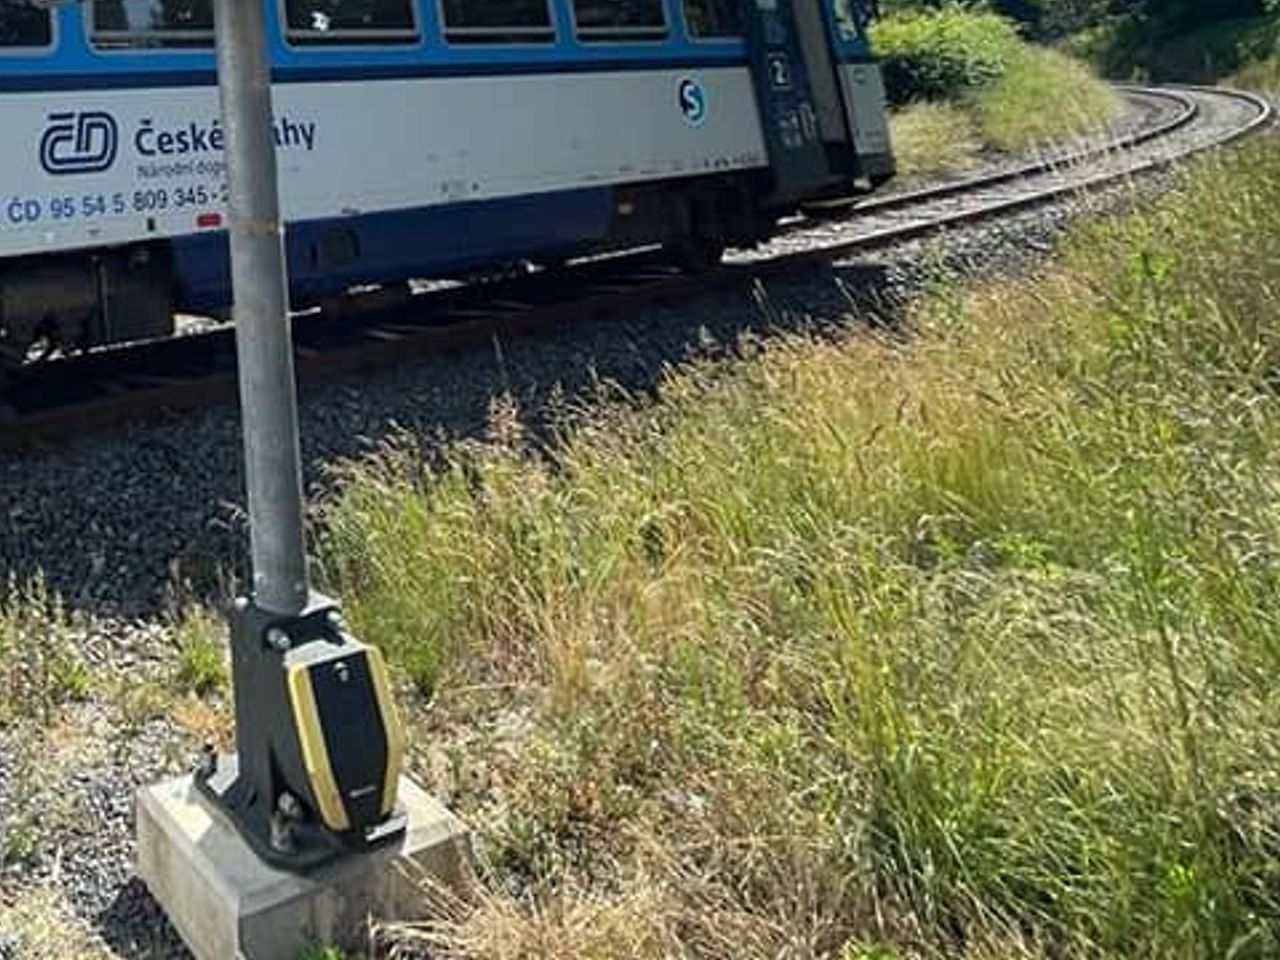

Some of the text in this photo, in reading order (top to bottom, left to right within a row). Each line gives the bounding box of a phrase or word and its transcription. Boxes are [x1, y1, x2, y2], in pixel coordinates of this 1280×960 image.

[135, 119, 226, 156] České
[7, 197, 42, 223] ČD
[50, 197, 75, 219] 95
[82, 195, 106, 217] 54
[112, 192, 125, 213] 5
[133, 189, 167, 212] 809
